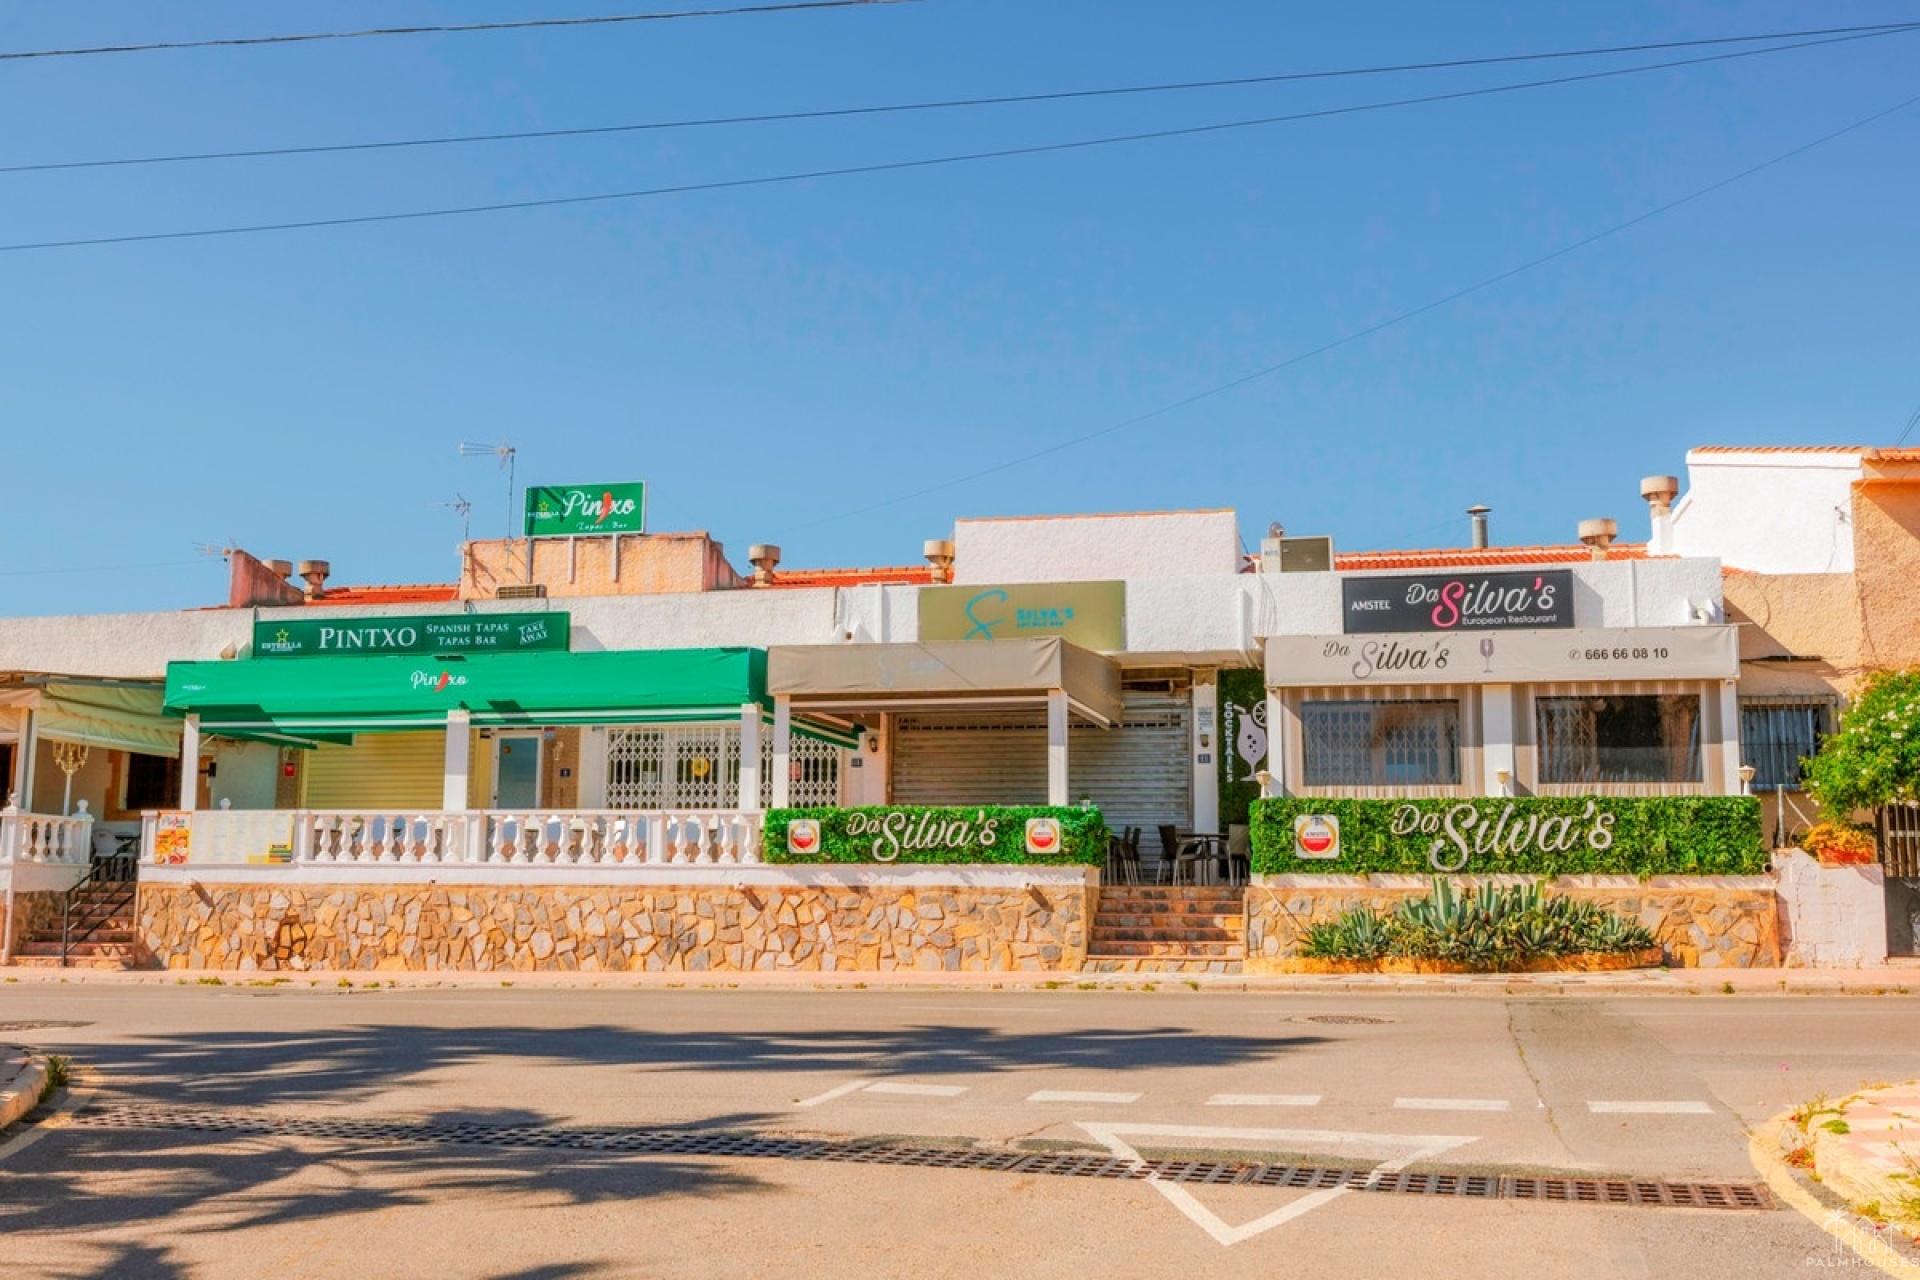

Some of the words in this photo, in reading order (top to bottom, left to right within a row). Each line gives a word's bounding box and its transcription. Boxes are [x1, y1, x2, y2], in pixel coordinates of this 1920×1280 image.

[1351, 599, 1391, 611] AMSTEL
[1406, 583, 1440, 604] Da
[1431, 576, 1557, 628] Silva's
[517, 619, 545, 635] TAKE
[1462, 614, 1506, 626] European
[1508, 612, 1558, 625] Restaurant
[319, 626, 417, 649] PINTXO
[426, 623, 470, 634] SPANISH
[475, 622, 510, 633] TAPAS
[438, 636, 471, 646] TAPAS
[475, 634, 497, 645] BAR
[519, 629, 548, 646] AWAY
[1323, 641, 1350, 658] Da
[1351, 640, 1450, 680] Silva's
[1585, 648, 1609, 660] 666
[1612, 647, 1628, 660] 66
[1632, 647, 1648, 659] 08
[1653, 647, 1668, 659] 10
[1223, 701, 1234, 783] COCKTAILS
[845, 813, 879, 836] Da
[871, 810, 999, 862] Silva's
[1390, 804, 1442, 835] Da
[1430, 800, 1615, 873] Silva's
